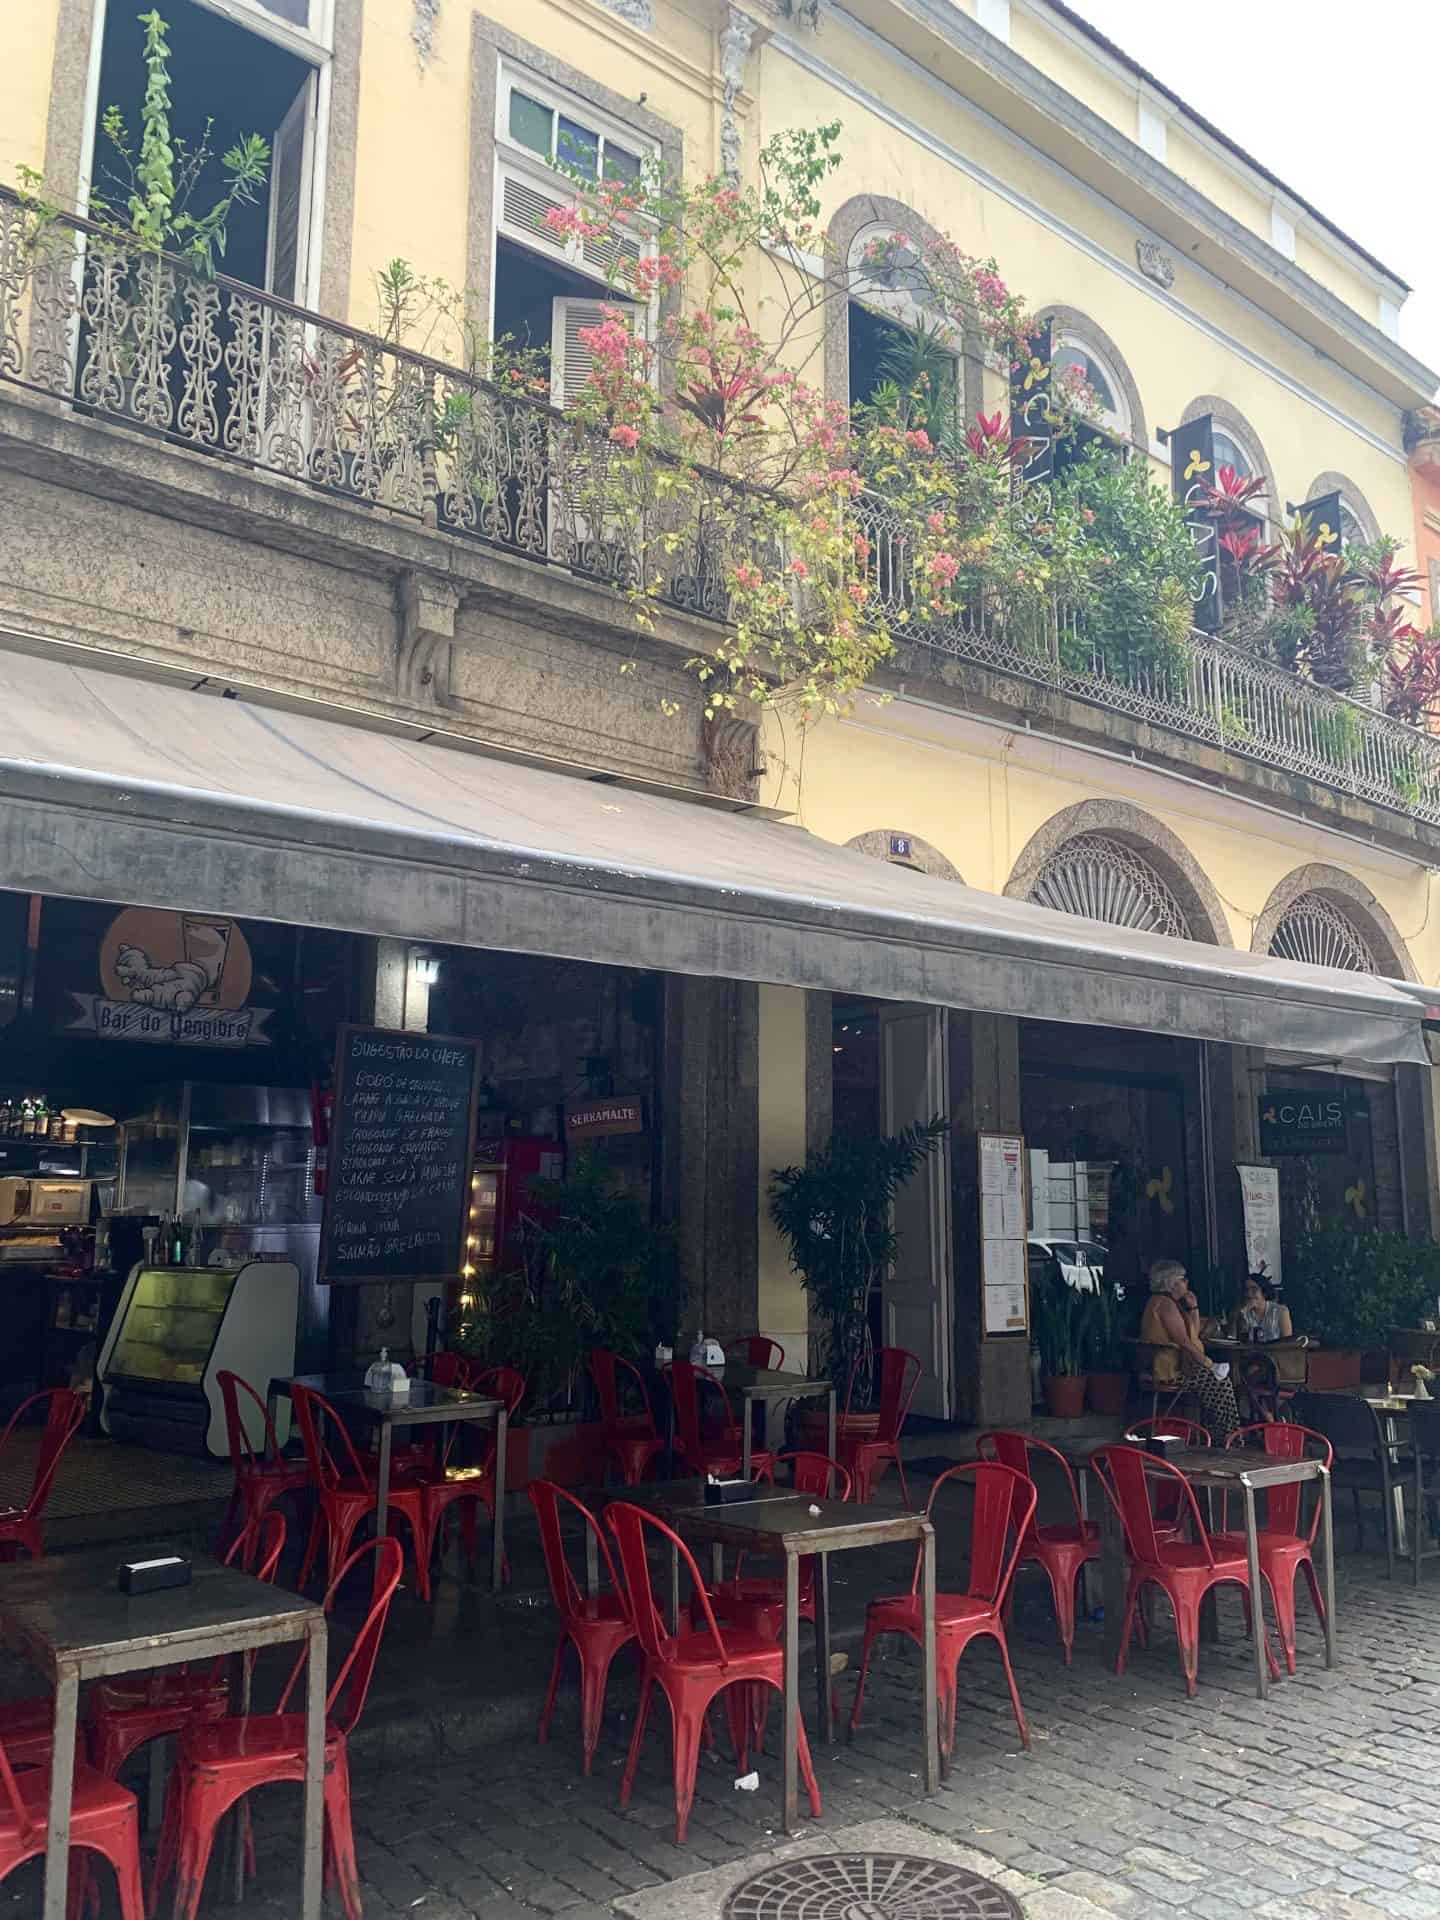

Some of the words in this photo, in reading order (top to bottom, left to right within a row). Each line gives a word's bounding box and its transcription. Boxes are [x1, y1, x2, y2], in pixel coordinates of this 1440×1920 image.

[897, 839, 905, 854] 8
[101, 1007, 131, 1030] Bar
[141, 1013, 161, 1032] do
[432, 1046, 465, 1067] CHEFE
[571, 1107, 635, 1128] SERRAMALTE
[1280, 1101, 1343, 1124] CAIS
